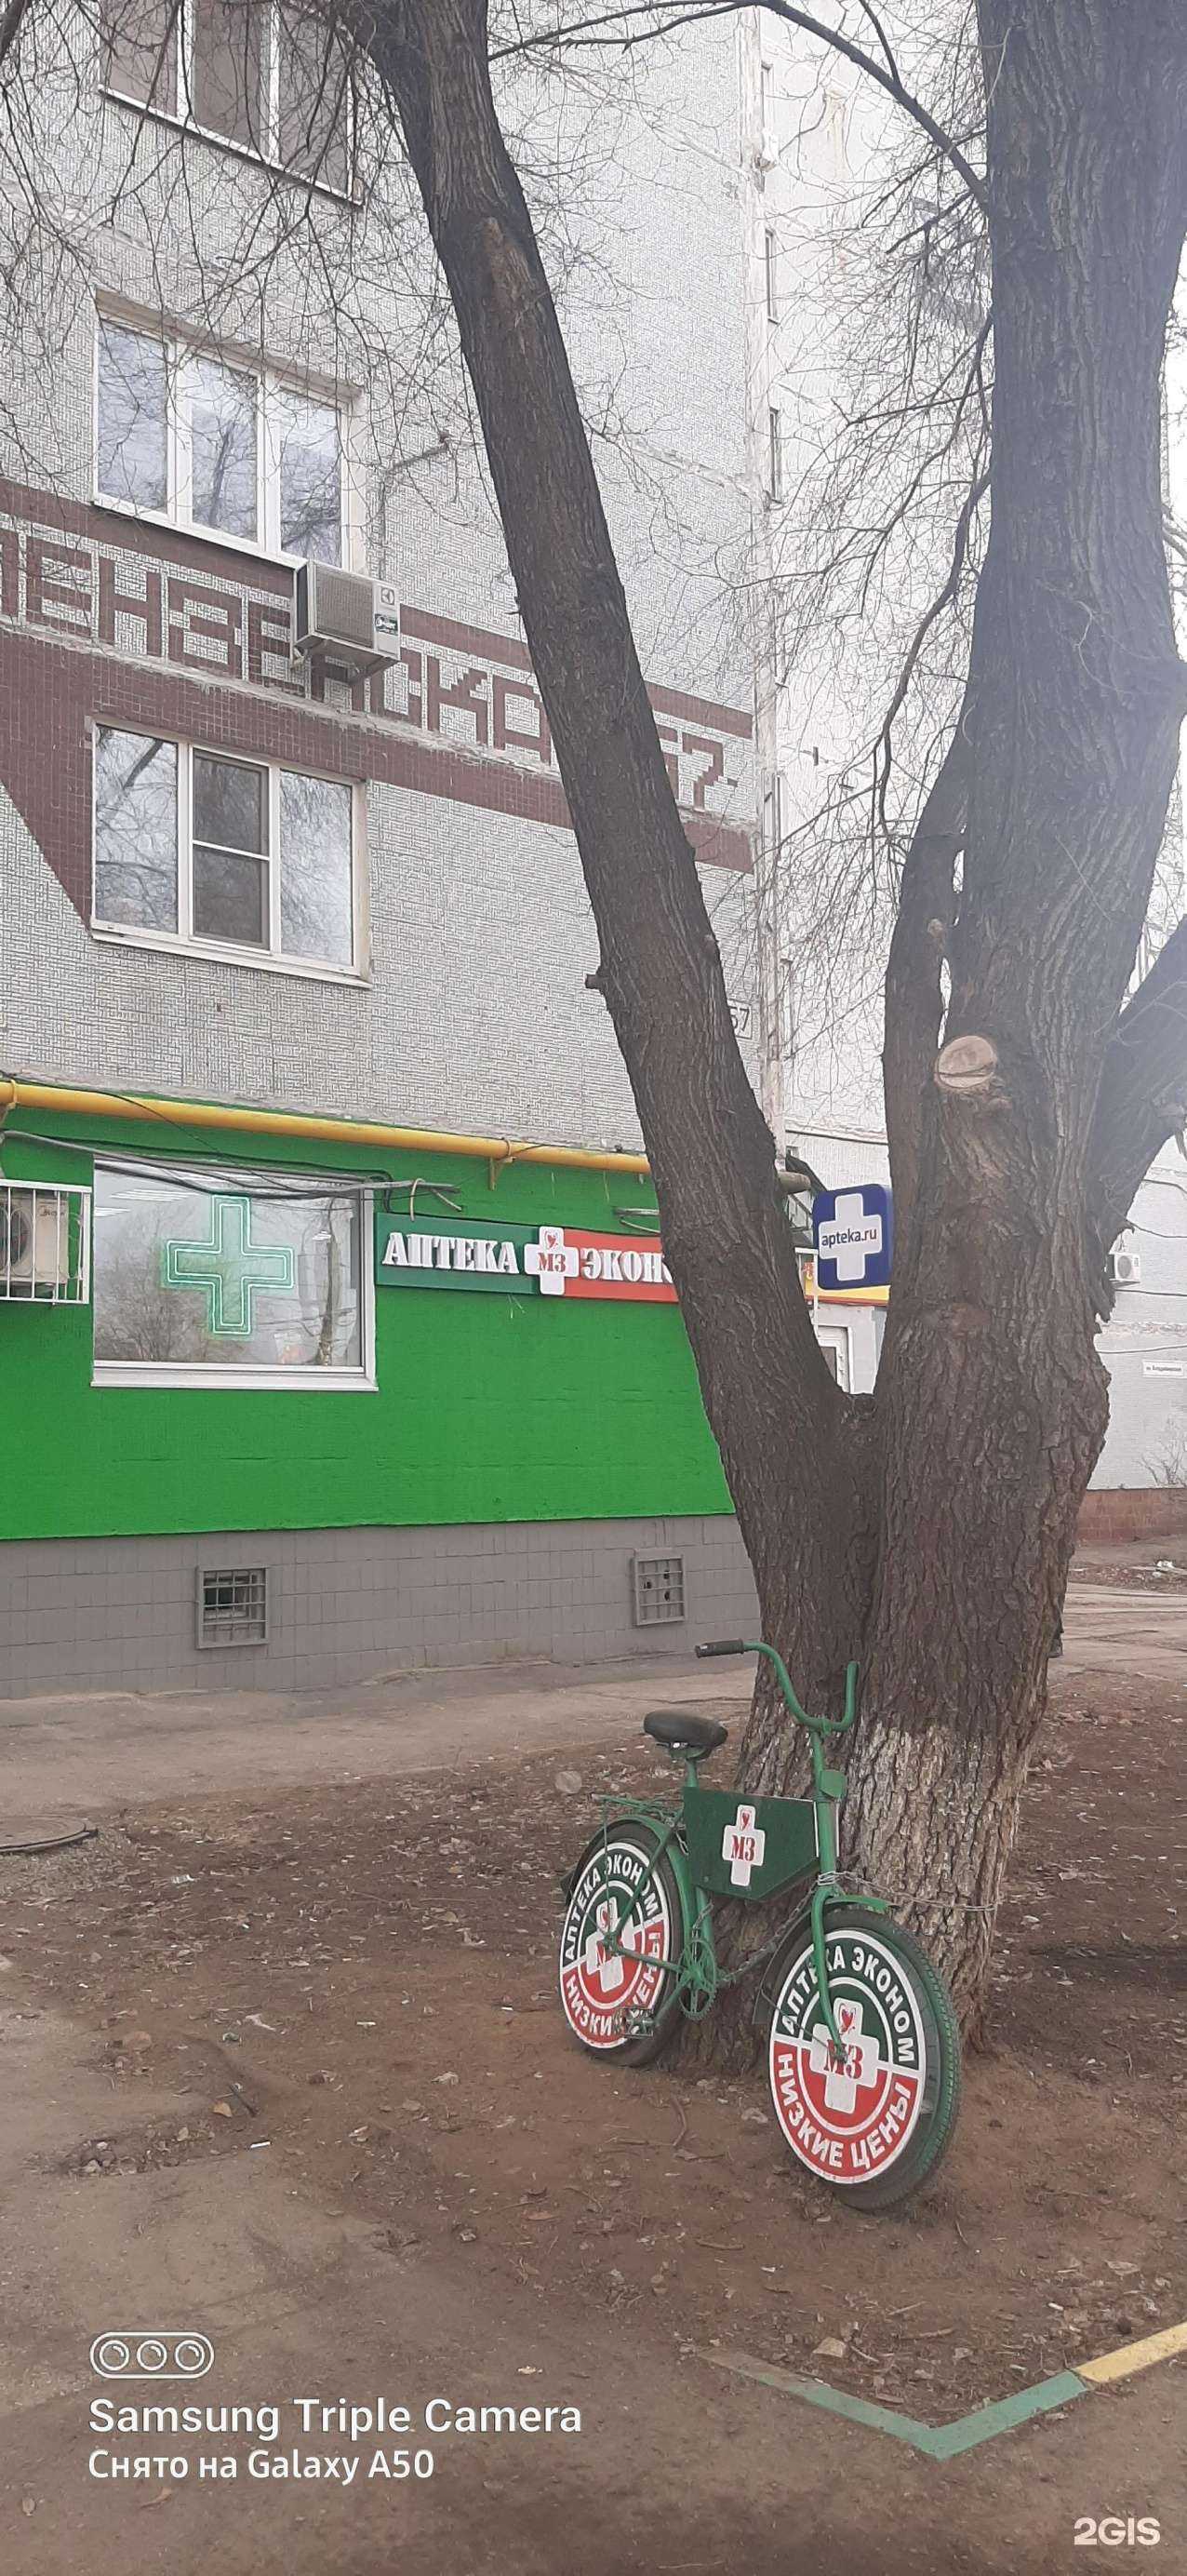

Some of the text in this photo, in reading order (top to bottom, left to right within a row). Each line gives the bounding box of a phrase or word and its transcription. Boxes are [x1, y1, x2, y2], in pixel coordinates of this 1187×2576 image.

[382, 1232, 519, 1274] АПТЕКА
[821, 1228, 877, 1248] apteka.ru
[565, 1867, 602, 1961] АПТЕКА
[566, 1973, 623, 2037] НИЗКИ
[851, 1946, 916, 2062] ЭКОНОМ
[778, 2053, 912, 2170] НИЗКИЕ ЦЕНЫ
